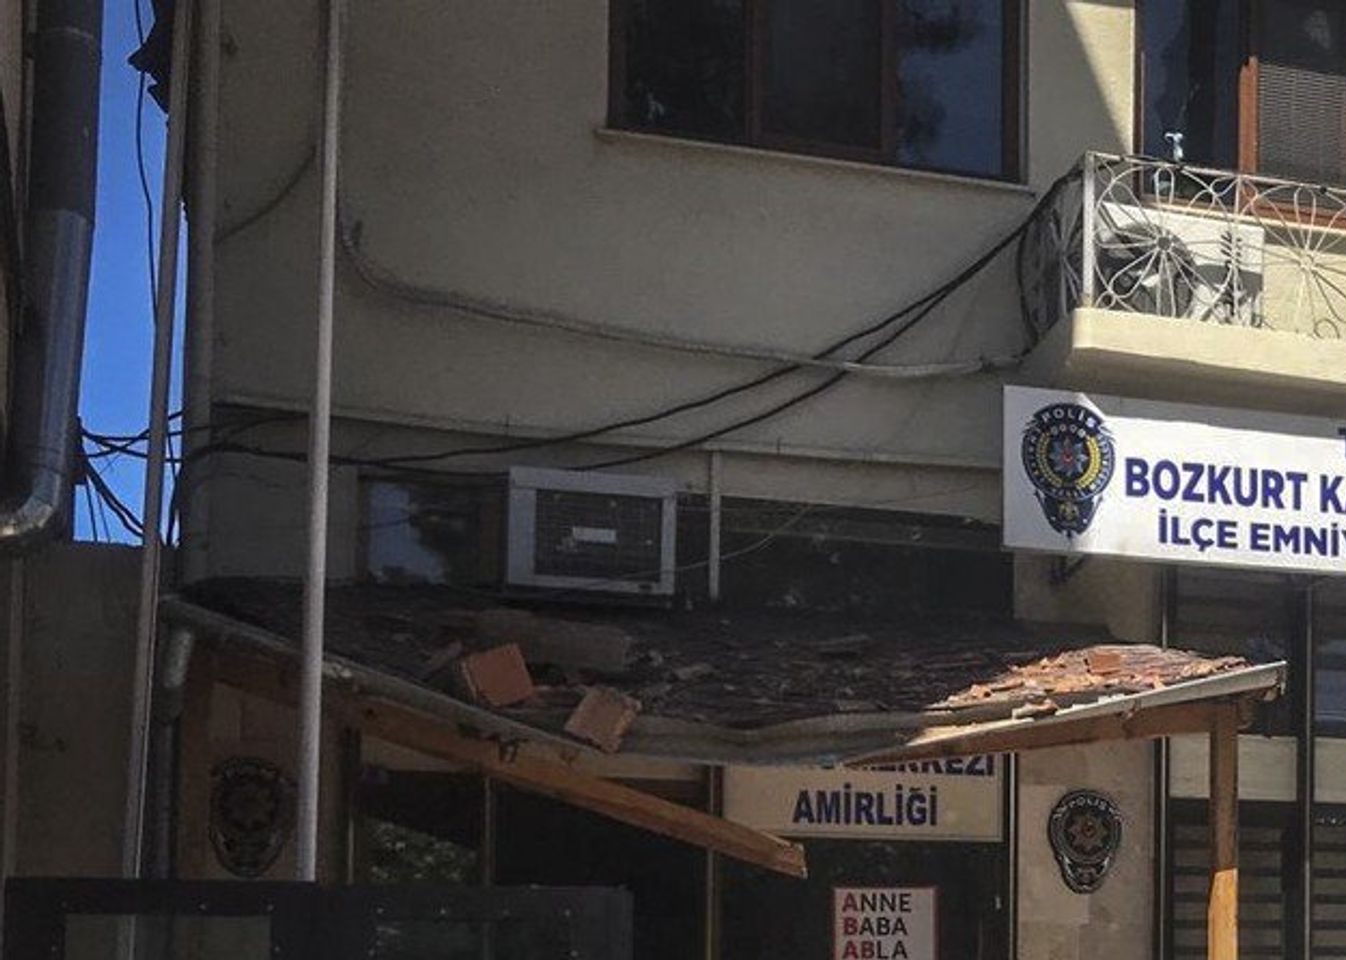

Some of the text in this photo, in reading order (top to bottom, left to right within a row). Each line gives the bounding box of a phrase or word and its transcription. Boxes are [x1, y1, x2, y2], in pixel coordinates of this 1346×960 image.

[1125, 457, 1308, 510] BOZKURT
[1158, 509, 1238, 551] İLÇE
[792, 783, 937, 826] AMİRLİĞİ
[842, 892, 912, 912] ANNE
[842, 916, 908, 936] BABA
[842, 940, 908, 959] ABLA
